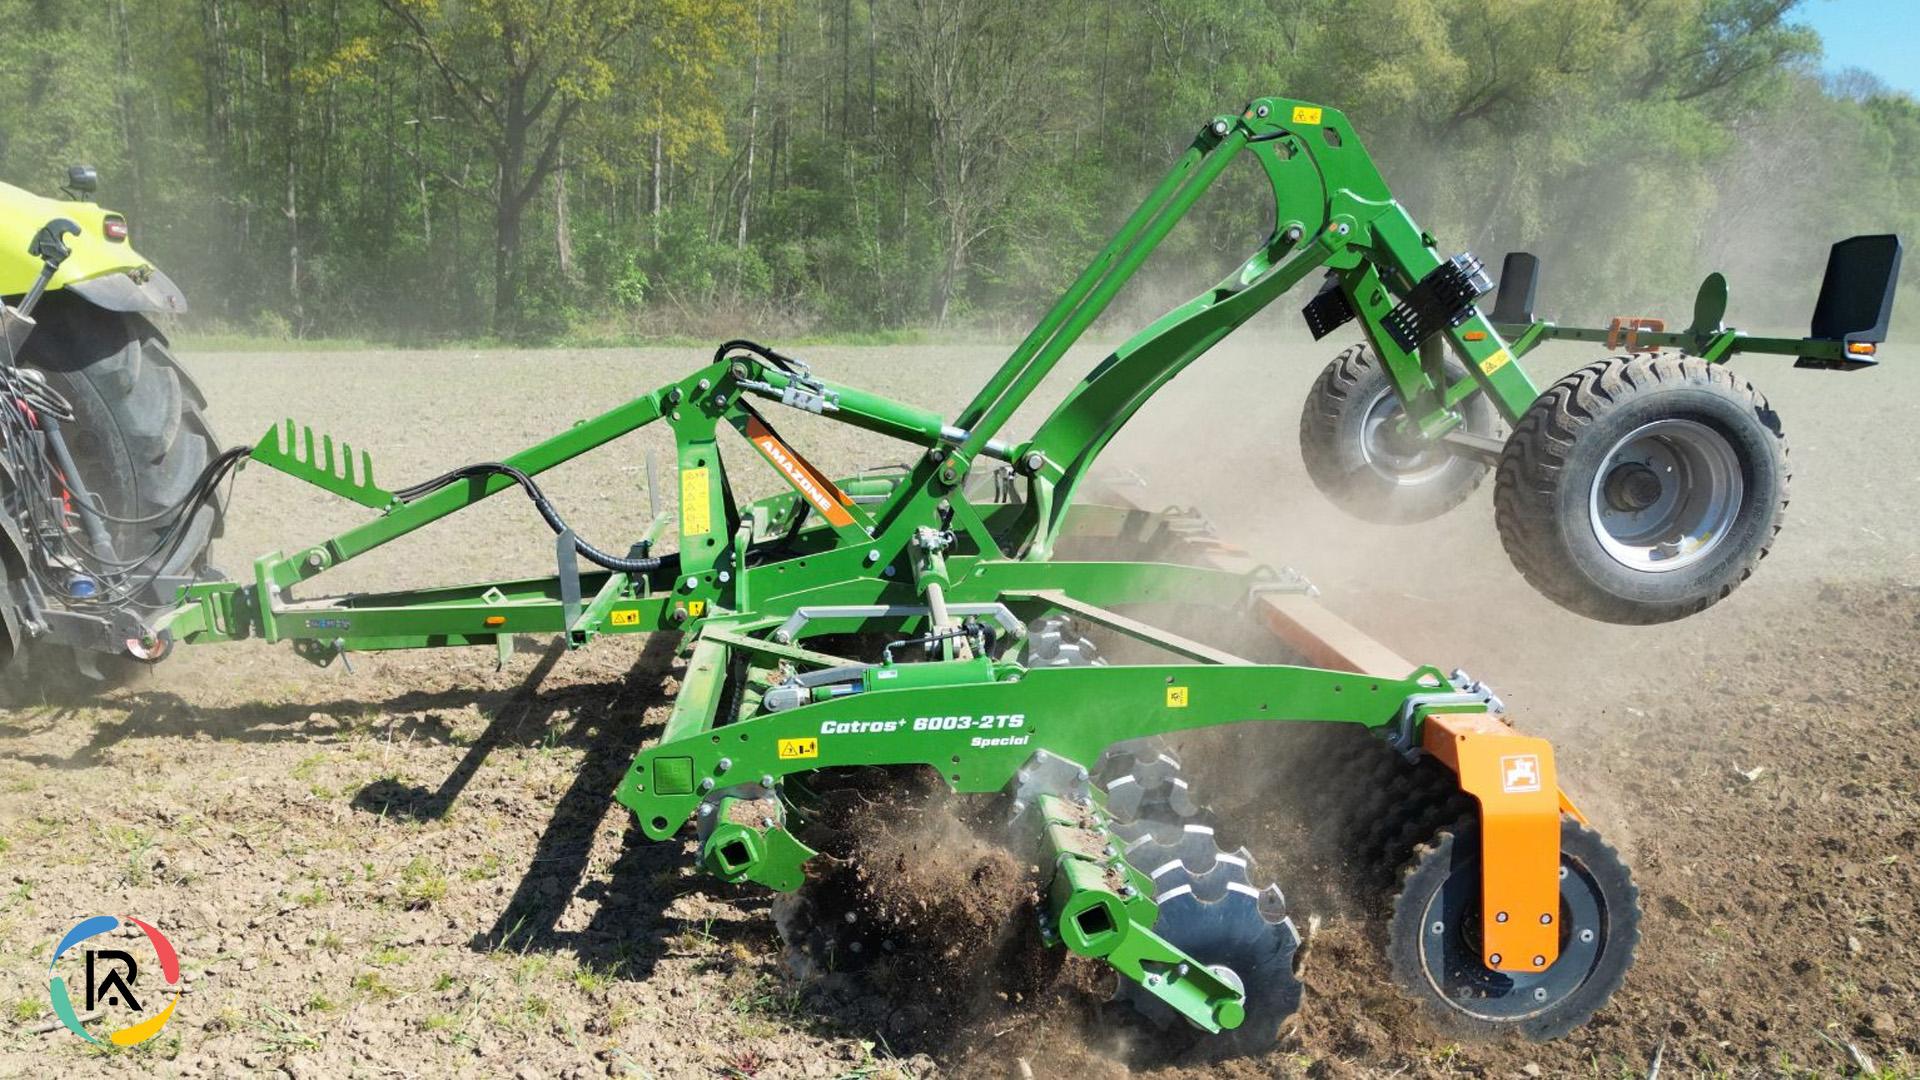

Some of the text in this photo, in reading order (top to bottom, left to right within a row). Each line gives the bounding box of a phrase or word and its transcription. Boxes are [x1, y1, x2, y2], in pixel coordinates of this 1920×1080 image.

[761, 440, 832, 511] AMAZONE
[820, 714, 1025, 734] Catros+ 6003-2TS
[971, 735, 1029, 748] Special
